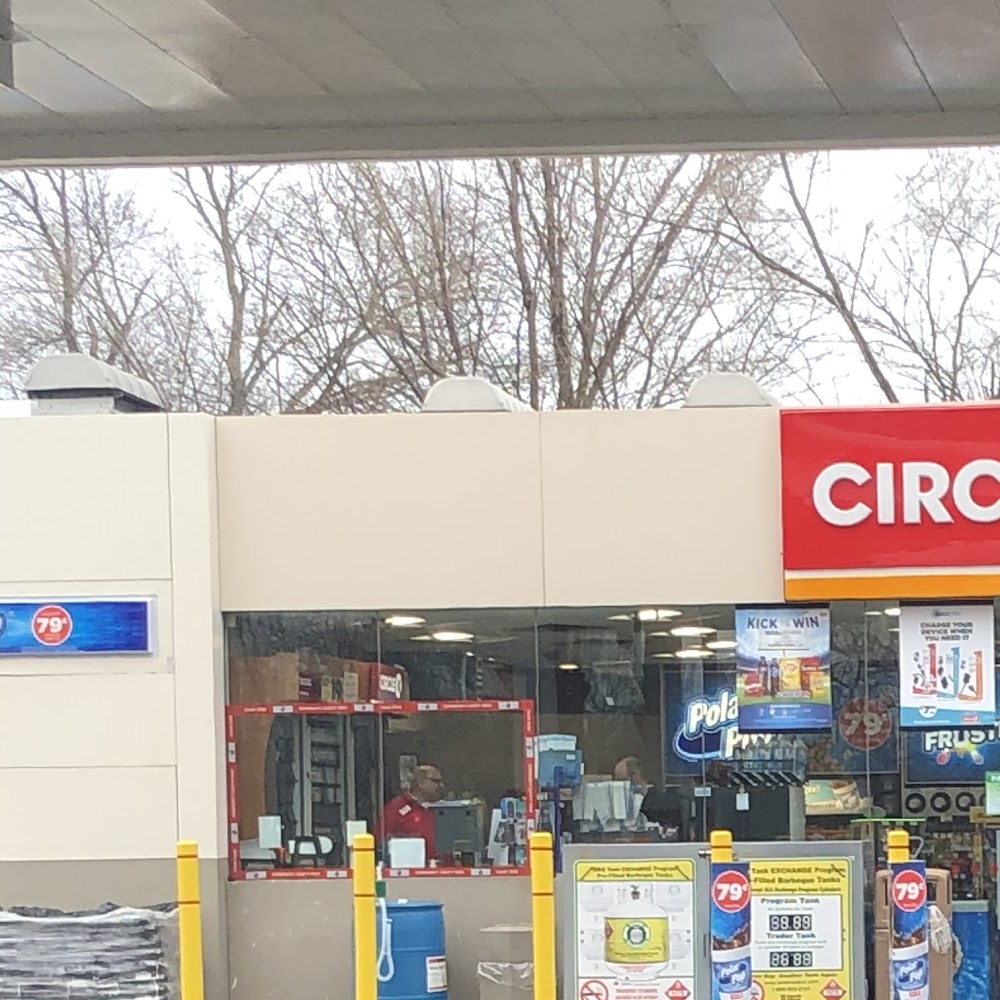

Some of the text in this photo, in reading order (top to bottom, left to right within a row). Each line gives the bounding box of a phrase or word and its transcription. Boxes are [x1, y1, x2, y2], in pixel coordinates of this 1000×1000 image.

[747, 616, 778, 629] KICK
[792, 616, 820, 628] WIN
[777, 877, 816, 885] Barbeque
[716, 882, 748, 902] 79¢
[895, 882, 925, 901] 79¢
[761, 897, 797, 905] Program
